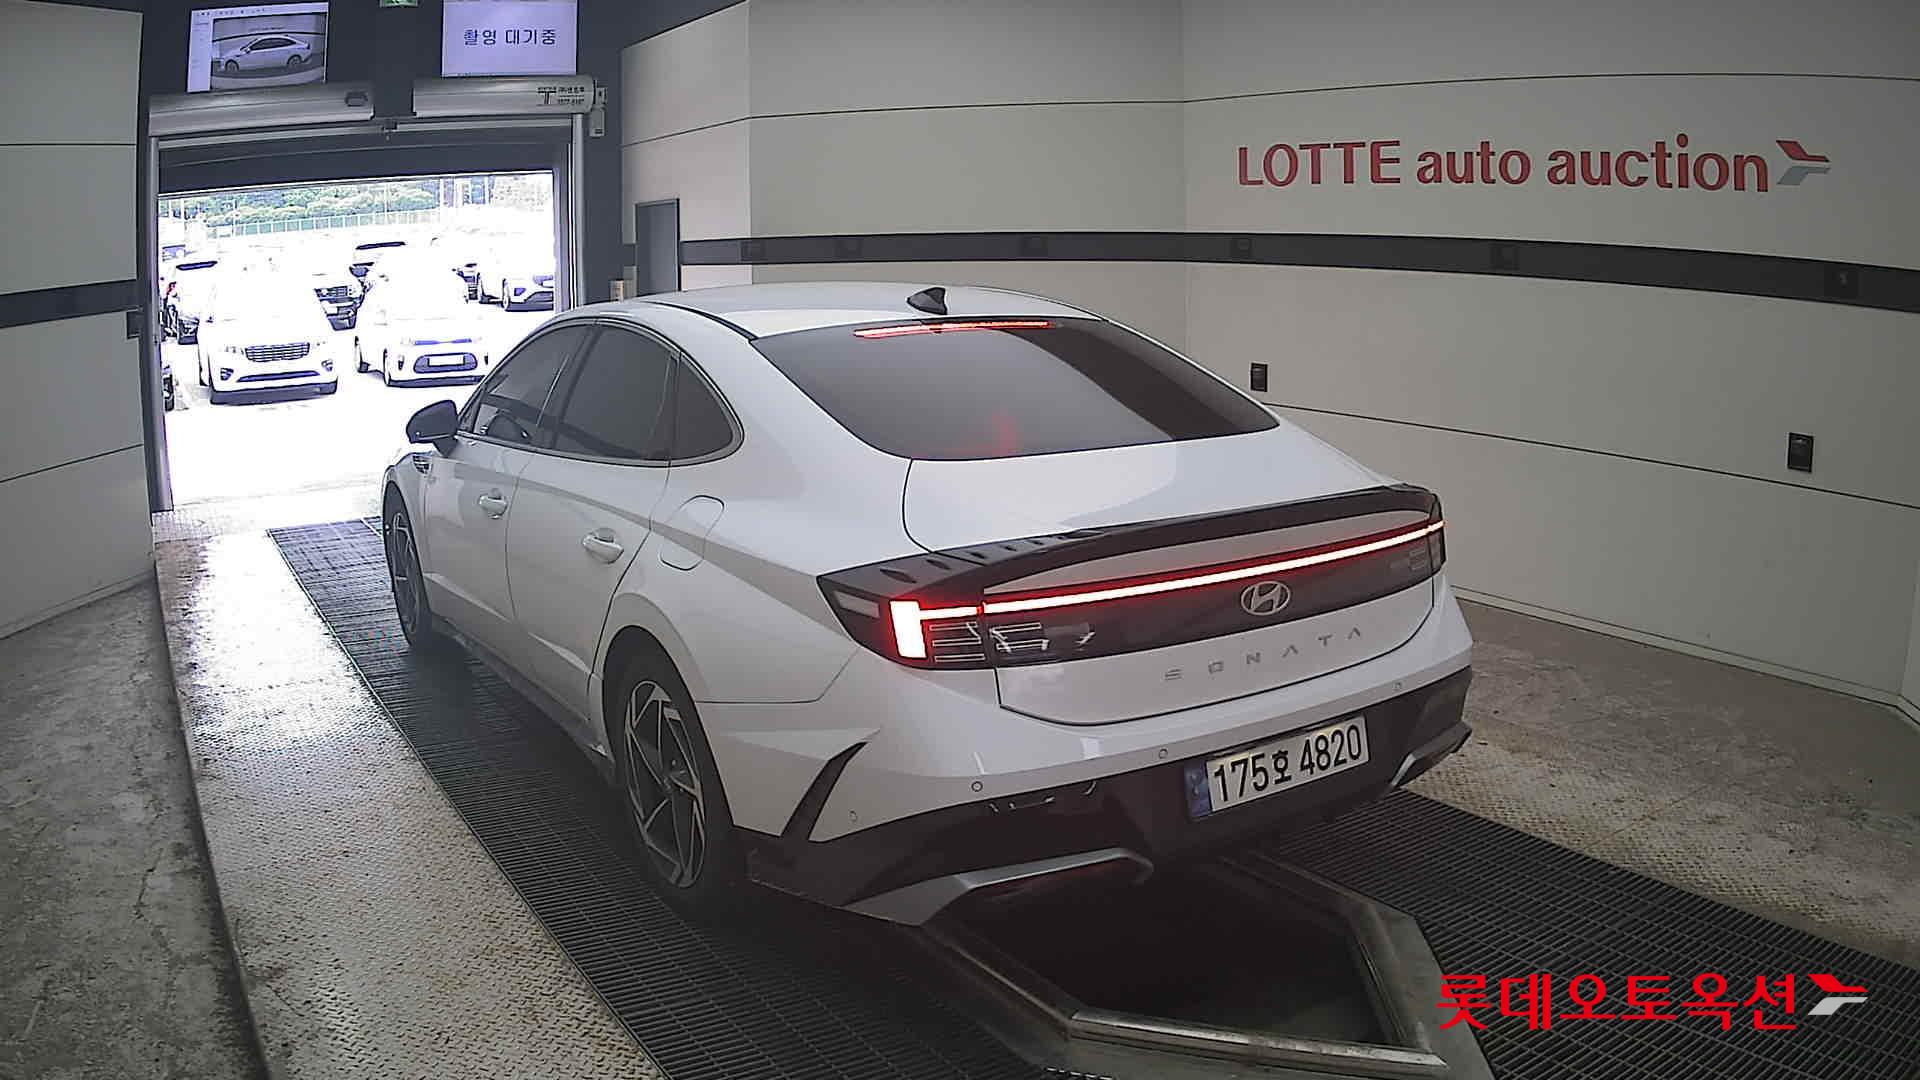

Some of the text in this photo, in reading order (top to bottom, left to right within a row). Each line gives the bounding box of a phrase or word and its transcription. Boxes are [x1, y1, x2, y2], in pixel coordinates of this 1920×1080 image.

[463, 29, 556, 46] 촬영 대기중
[1237, 133, 1769, 193] LOTTE auto auction
[1164, 627, 1362, 681] SONATA
[1214, 724, 1362, 802] 175호 4820
